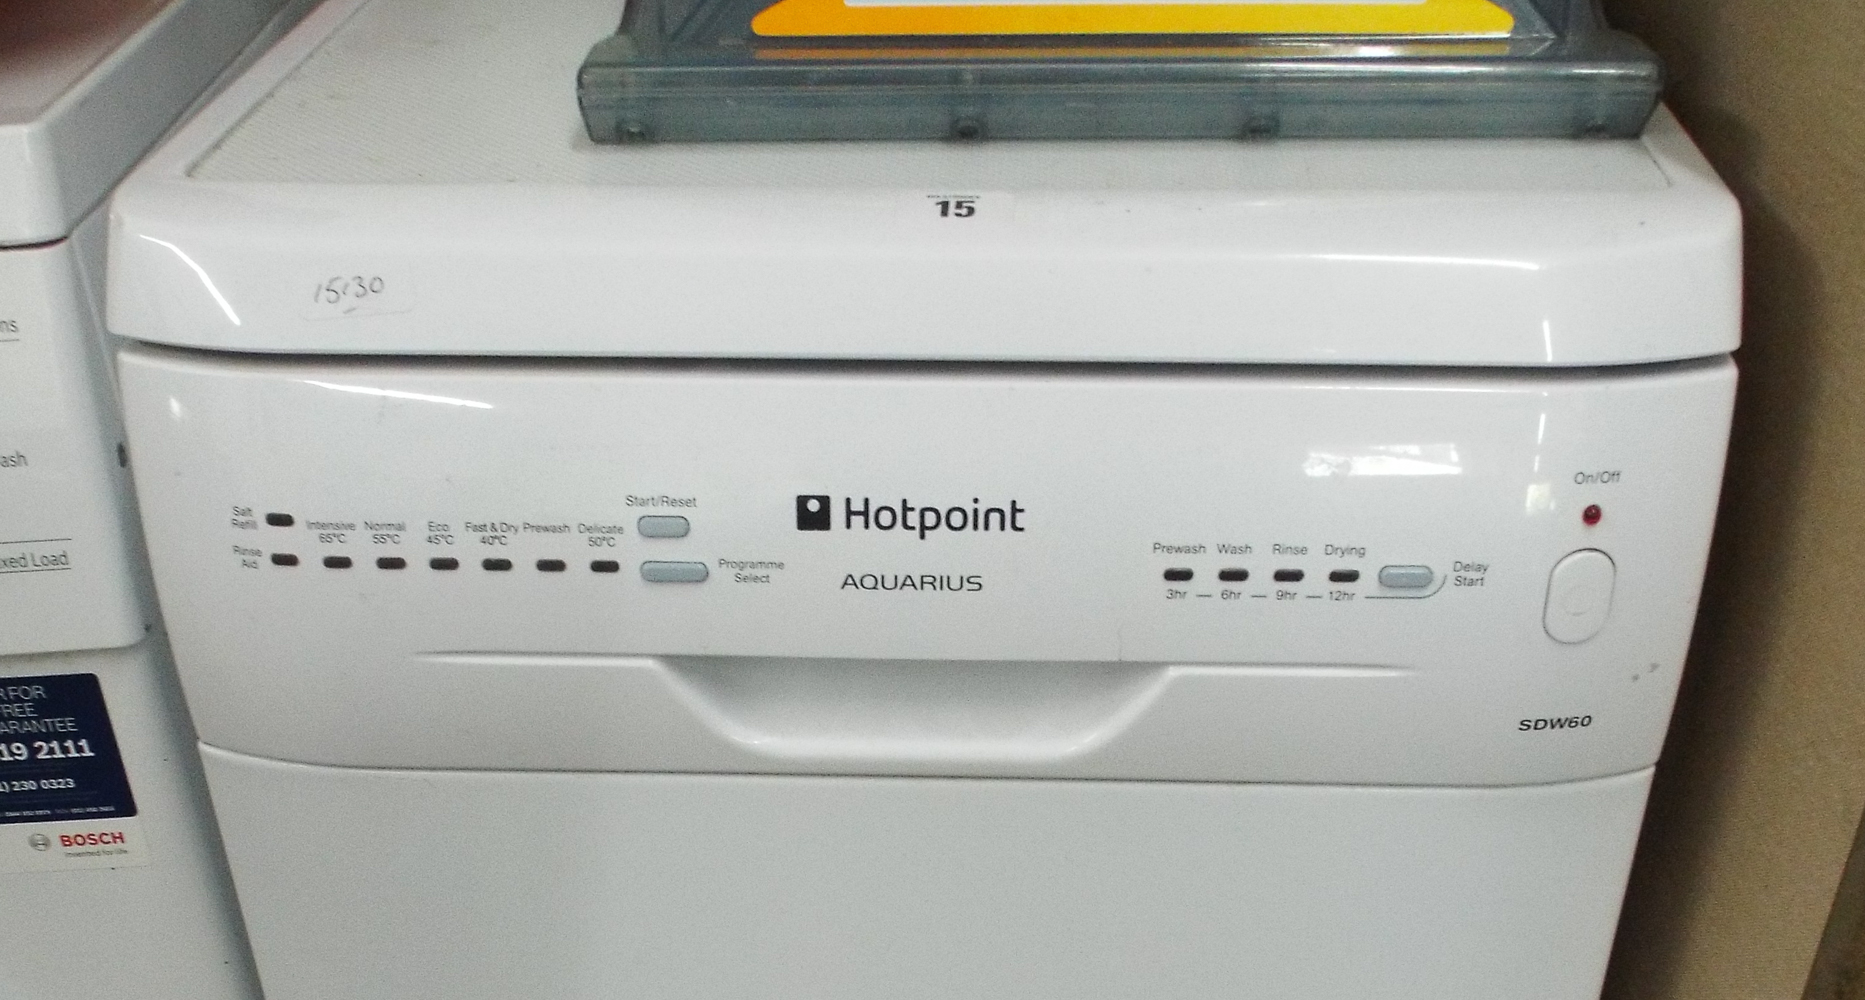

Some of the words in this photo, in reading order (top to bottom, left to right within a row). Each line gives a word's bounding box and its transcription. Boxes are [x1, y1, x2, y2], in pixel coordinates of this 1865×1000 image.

[936, 200, 976, 218] 15
[1574, 471, 1622, 485] On/Off
[626, 495, 697, 509] Start/Reset
[232, 506, 253, 517] Salt
[845, 497, 1025, 540] Hotpoint
[306, 521, 356, 531] Intensive
[364, 521, 407, 531] Normal
[428, 521, 449, 532] Eco
[465, 523, 488, 533] Fast
[490, 523, 498, 533] &
[500, 523, 519, 535] Dry
[523, 523, 571, 534] Prewash
[577, 524, 624, 535] Delicate
[232, 545, 263, 557] Rinse
[1153, 542, 1206, 555] Prewash
[1217, 543, 1253, 555] Wash
[1273, 543, 1308, 556] Rinse
[1325, 544, 1366, 558] Drying
[31, 550, 69, 567] Load
[241, 559, 259, 570] Aid
[718, 558, 785, 572] Programme
[1453, 561, 1490, 575] Delay
[734, 572, 770, 583] Select
[841, 573, 983, 592] AQUARIUS
[1454, 575, 1486, 587] Start
[1166, 588, 1187, 600] 3hr
[1221, 588, 1242, 600] 6hr
[1276, 589, 1297, 601] 9hr
[1329, 589, 1356, 602] 12hr
[8, 685, 47, 700] FOR
[1518, 715, 1593, 732] SDW60
[33, 739, 95, 760] 2111
[11, 780, 38, 791] 230
[40, 778, 76, 790] 0323
[60, 831, 125, 847] BOSCH
